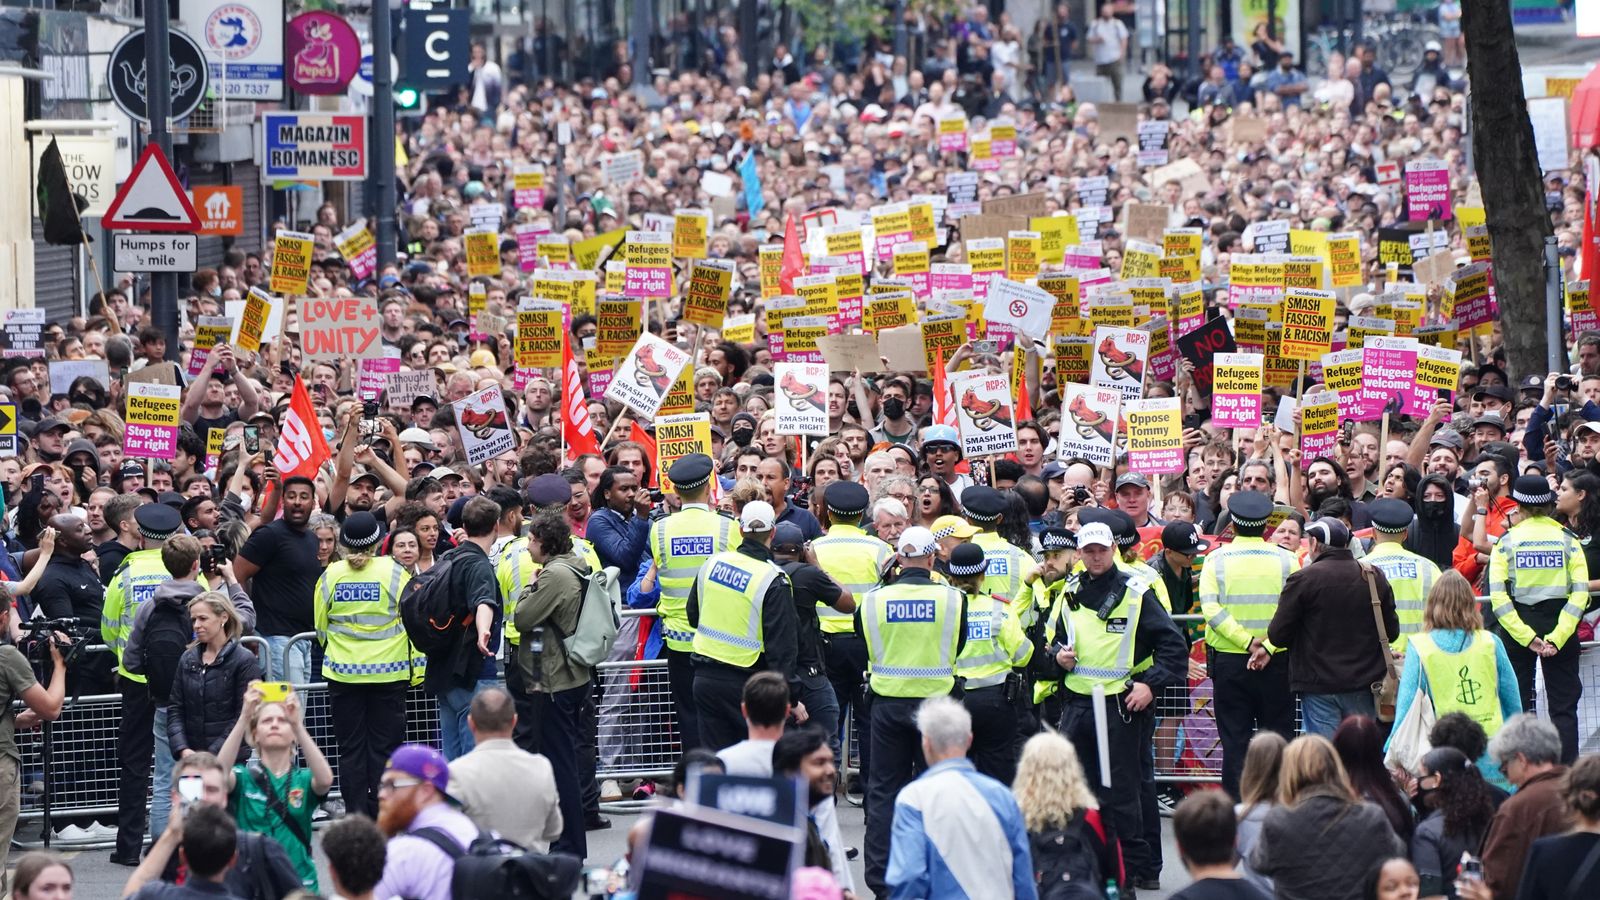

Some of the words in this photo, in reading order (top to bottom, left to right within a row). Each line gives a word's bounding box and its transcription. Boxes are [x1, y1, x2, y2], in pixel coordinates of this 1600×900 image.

[298, 63, 333, 78] Pepe's
[279, 126, 350, 143] MAGAZIN
[64, 154, 84, 163] THE
[271, 150, 359, 168] ROMANESC
[65, 165, 101, 180] OW
[1408, 183, 1448, 194] Refugees
[1410, 193, 1446, 203] welcome
[1410, 202, 1429, 211] here
[220, 220, 237, 229] EAT
[121, 239, 165, 251] Humps
[172, 239, 190, 250] for
[278, 239, 302, 249] SMASH
[628, 245, 669, 255] Refugees
[148, 254, 175, 266] mile
[275, 252, 305, 263] FASCISM
[628, 256, 667, 264] welcome
[970, 252, 1003, 260] Refugees
[1011, 252, 1036, 260] FASCISM
[972, 261, 1002, 269] welcome
[1284, 264, 1311, 274] SMASH
[273, 268, 280, 276] &
[282, 267, 308, 278] RACISM
[628, 269, 648, 279] Stop
[651, 269, 665, 278] the
[693, 268, 720, 281] SMASH
[628, 281, 641, 289] far
[643, 281, 665, 291] right
[1284, 277, 1317, 287] FASCISM
[691, 282, 723, 296] FASCISM
[796, 287, 828, 297] Oppose
[687, 296, 693, 304] &
[696, 295, 725, 310] RACISM
[872, 301, 898, 313] SMASH
[1287, 298, 1320, 311] SMASH
[600, 304, 628, 314] SMASH
[1092, 308, 1132, 318] Refugees
[1455, 302, 1476, 315] Stop
[519, 314, 548, 324] SMASH
[600, 316, 633, 327] FASCISM
[873, 314, 907, 326] FASCISM
[1286, 313, 1326, 327] FASCISM
[1573, 313, 1597, 322] Black
[923, 323, 952, 335] SMASH
[1236, 319, 1265, 331] Refugees
[1573, 322, 1596, 330] Lives
[519, 327, 555, 338] FASCISM
[607, 329, 638, 340] RACISM
[786, 330, 826, 339] Refugees
[1126, 333, 1140, 343] RCP
[1236, 333, 1265, 342] welcome
[1284, 329, 1291, 340] &
[1294, 328, 1330, 343] RACISM
[303, 327, 379, 355] UNITY
[520, 342, 526, 351] &
[529, 340, 560, 351] RACISM
[925, 335, 961, 349] FASCISM
[1194, 329, 1226, 358] NO
[1057, 346, 1083, 357] SMASH
[1366, 351, 1376, 359] Say
[1057, 360, 1089, 370] FASCISM
[1365, 357, 1377, 366] Say
[387, 374, 391, 384] I
[393, 370, 430, 383] thought
[1216, 367, 1259, 380] Refugees
[1364, 366, 1414, 378] Refugees
[389, 385, 400, 394] all
[403, 383, 430, 392] lives
[1125, 385, 1141, 393] THE
[1216, 380, 1258, 390] welcome
[1363, 379, 1411, 389] welcome
[616, 380, 640, 399] SMASH
[640, 392, 657, 406] THE
[1363, 388, 1388, 400] here
[129, 398, 177, 411] Refugees
[611, 387, 627, 400] FAR
[629, 397, 655, 413] RIGHT!
[1215, 396, 1238, 409] Stop
[1240, 396, 1256, 407] the
[129, 411, 174, 422] welcome
[779, 415, 810, 423] SMASH
[1130, 414, 1170, 425] Oppose
[1215, 409, 1232, 419] far
[1234, 408, 1256, 422] right
[1305, 408, 1337, 420] Refugees
[664, 416, 684, 424] Socialist
[1304, 419, 1335, 431] welcome
[128, 426, 151, 439] Stop
[153, 428, 171, 438] the
[659, 425, 694, 440] SMASH
[779, 423, 795, 431] FAR
[1130, 425, 1169, 438] Tommy
[127, 436, 146, 448] far
[149, 439, 170, 452] right
[469, 442, 495, 456] SMASH
[497, 434, 512, 444] THE
[965, 435, 996, 445] SMASH
[1131, 437, 1180, 448] Robinson
[1304, 435, 1324, 448] Stop
[470, 453, 486, 463] FAR
[490, 440, 513, 455] RIGHT!
[660, 441, 704, 457] FASCISM
[966, 445, 983, 453] FAR
[987, 441, 1016, 451] RIGHT!
[1063, 441, 1095, 452] SMASH
[1082, 453, 1110, 463] RIGHT!
[1132, 452, 1147, 462] Stop
[1149, 451, 1177, 459] fascists
[1303, 451, 1317, 460] far
[662, 461, 669, 473] &
[1138, 460, 1151, 468] the
[1152, 460, 1164, 468] far
[1166, 458, 1182, 469] right
[673, 544, 711, 555] POLICE
[1516, 557, 1563, 569] POLICE
[711, 563, 752, 589] POLICE
[334, 590, 380, 601] POLICE
[888, 602, 933, 620] POLICE
